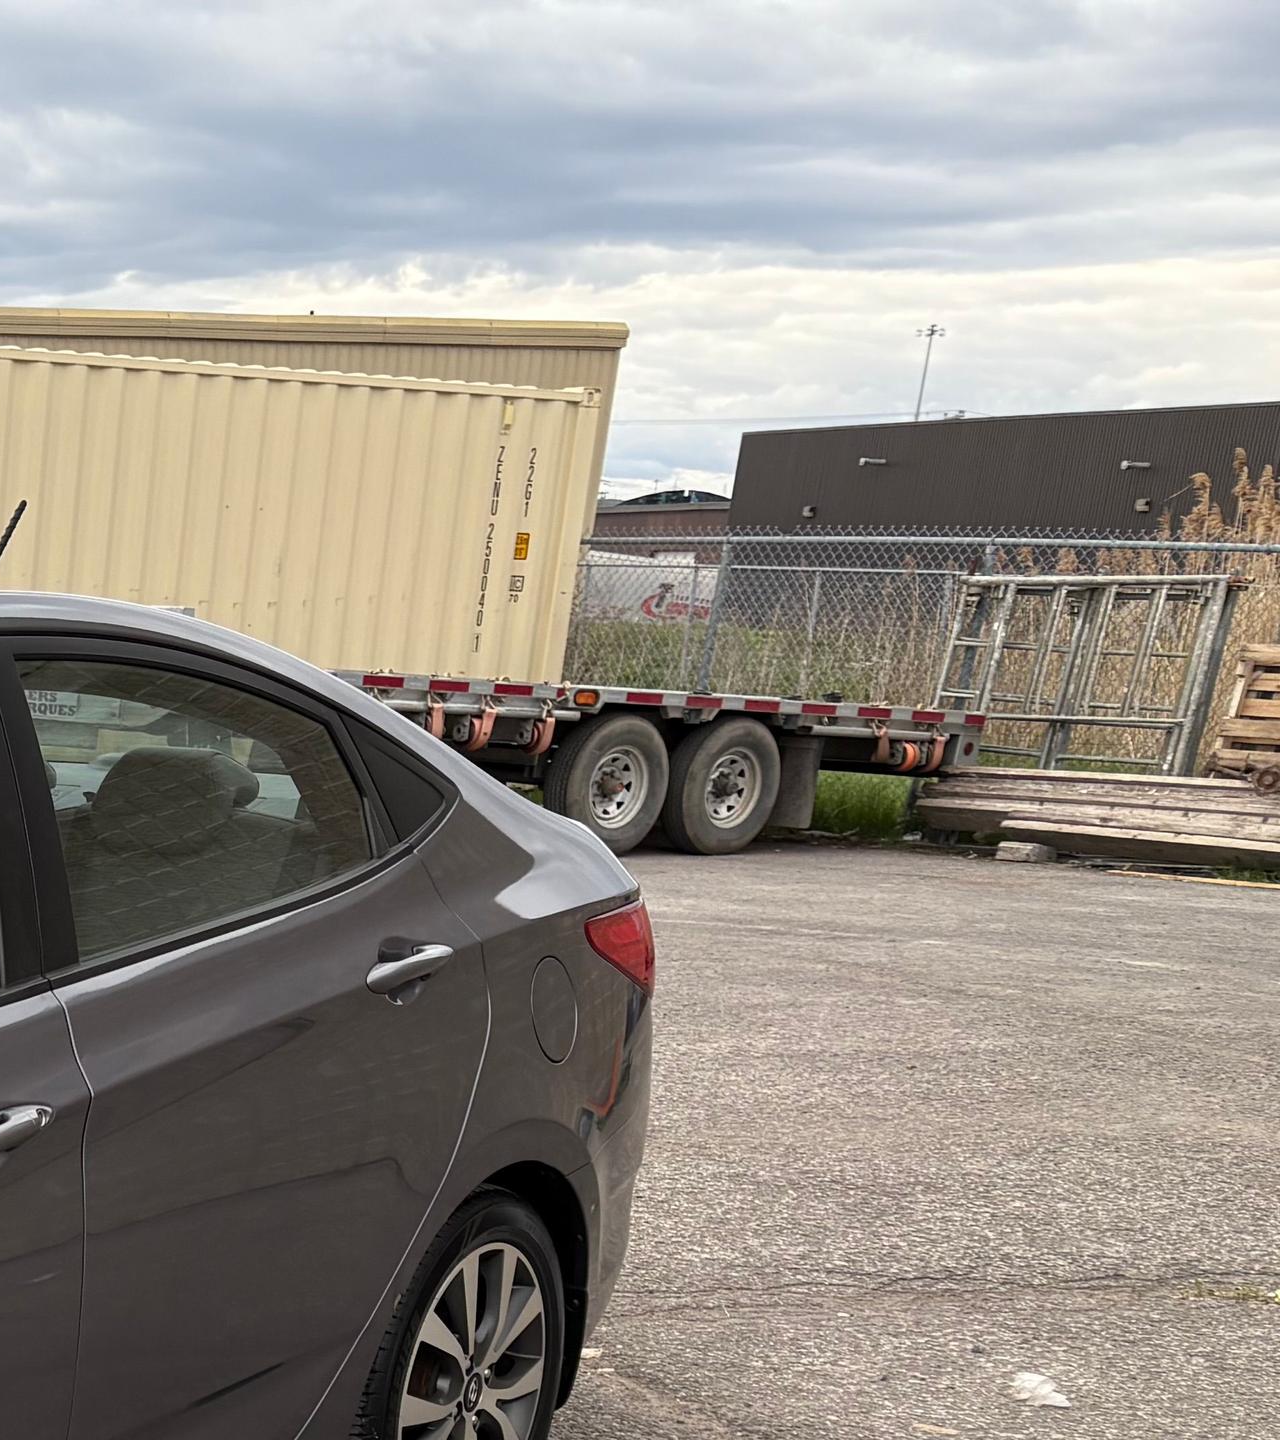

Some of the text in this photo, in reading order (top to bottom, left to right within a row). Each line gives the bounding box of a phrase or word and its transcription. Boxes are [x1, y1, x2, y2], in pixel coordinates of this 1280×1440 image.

[491, 445, 506, 516] ZENU
[524, 447, 538, 518] 22G1
[476, 522, 495, 627] 250040
